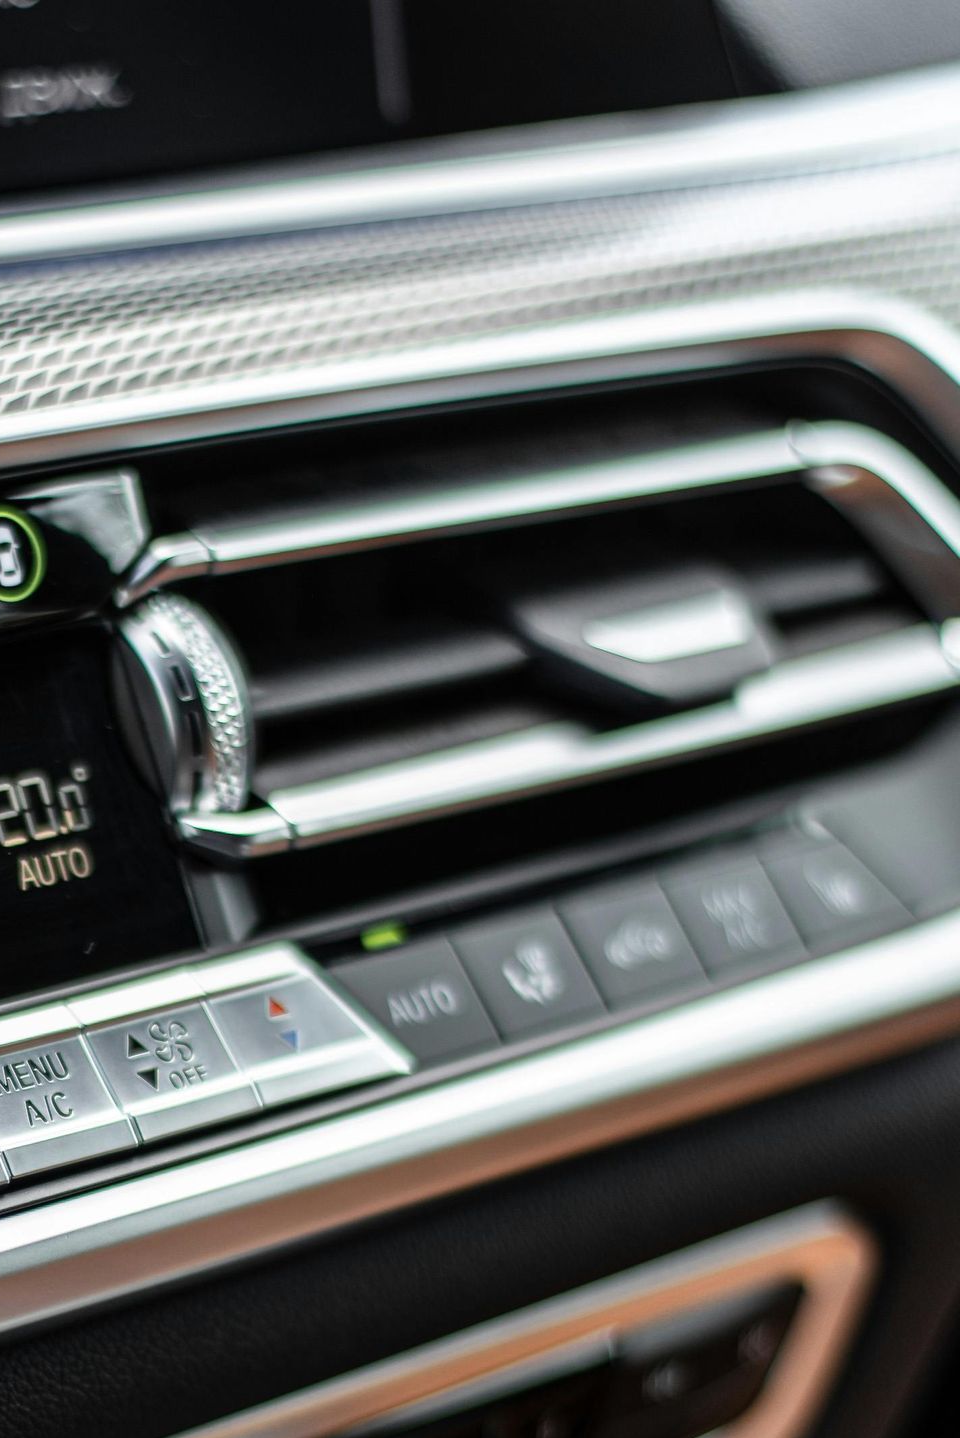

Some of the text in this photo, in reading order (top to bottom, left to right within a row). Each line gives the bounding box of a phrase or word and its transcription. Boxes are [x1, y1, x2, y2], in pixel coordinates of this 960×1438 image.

[17, 846, 94, 891] AUTO
[386, 983, 457, 1027] AUTO
[168, 1064, 209, 1090] OFF
[23, 1092, 74, 1127] A/C
